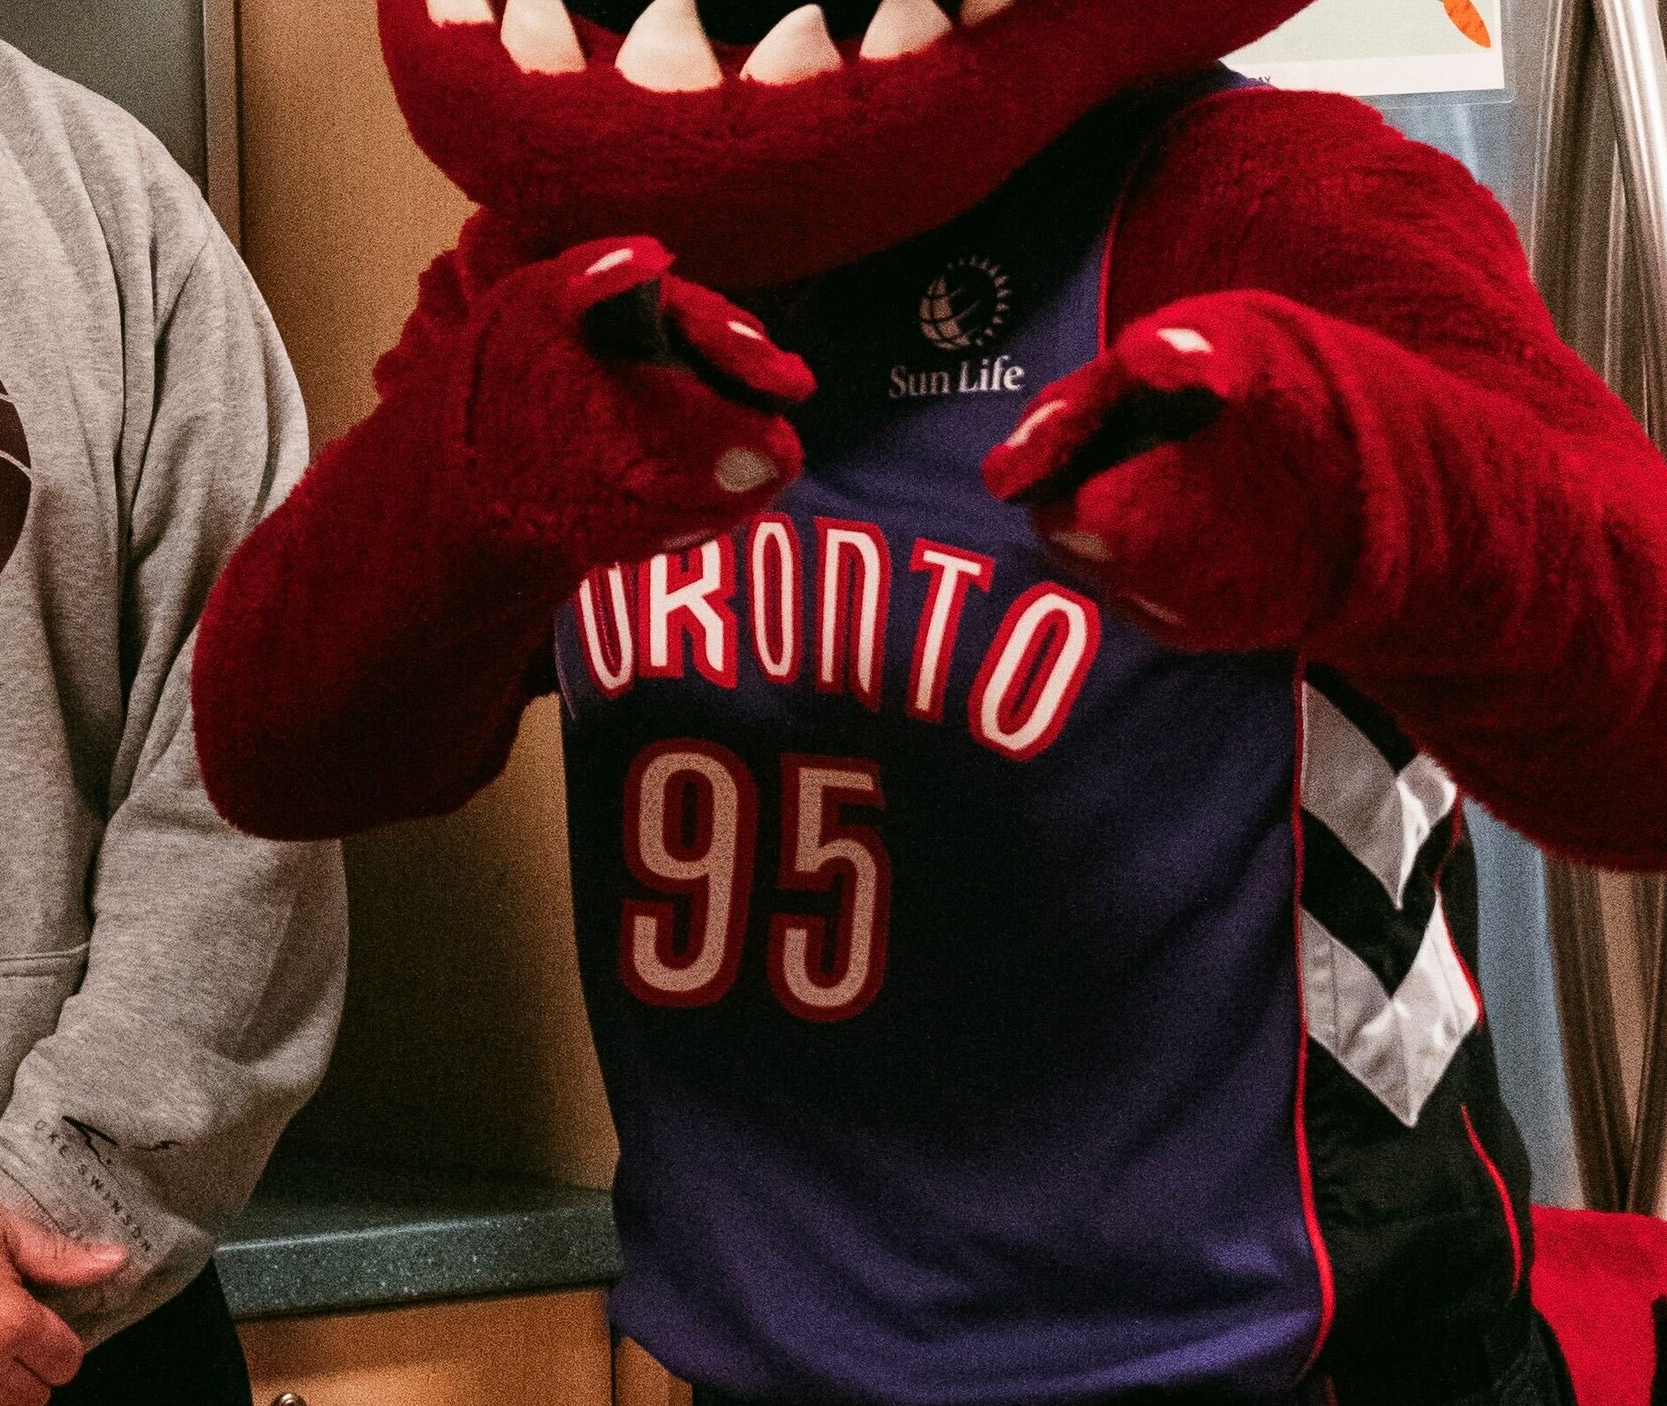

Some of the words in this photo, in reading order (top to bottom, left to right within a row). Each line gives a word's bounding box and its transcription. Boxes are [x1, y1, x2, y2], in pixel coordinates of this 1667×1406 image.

[889, 365, 950, 398] Sun
[957, 355, 1025, 393] Life
[576, 512, 1103, 762] ORONTO
[620, 739, 892, 1022] 95
